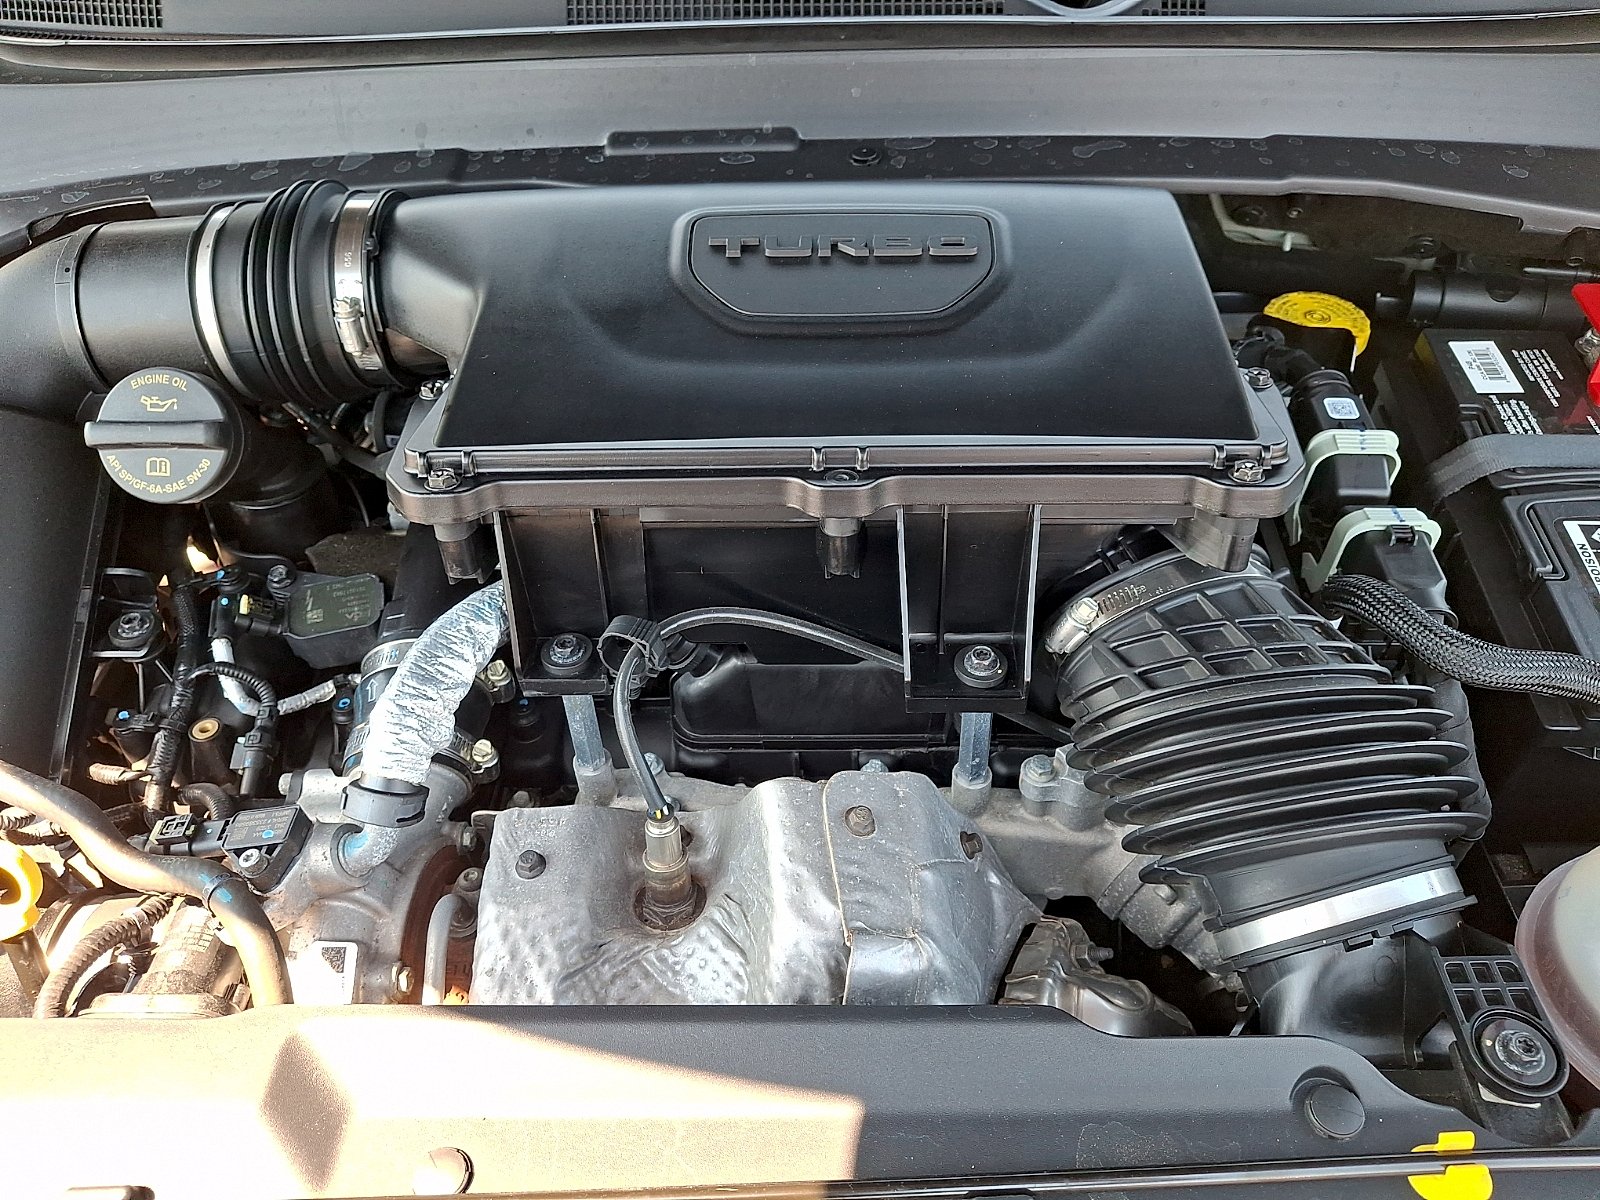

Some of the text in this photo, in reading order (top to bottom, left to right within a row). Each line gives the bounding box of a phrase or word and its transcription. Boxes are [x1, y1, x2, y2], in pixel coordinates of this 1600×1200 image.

[708, 234, 978, 258] TURBO
[130, 374, 188, 392] ENGINE OIL
[106, 454, 120, 472] API
[186, 458, 211, 485] 5W-30
